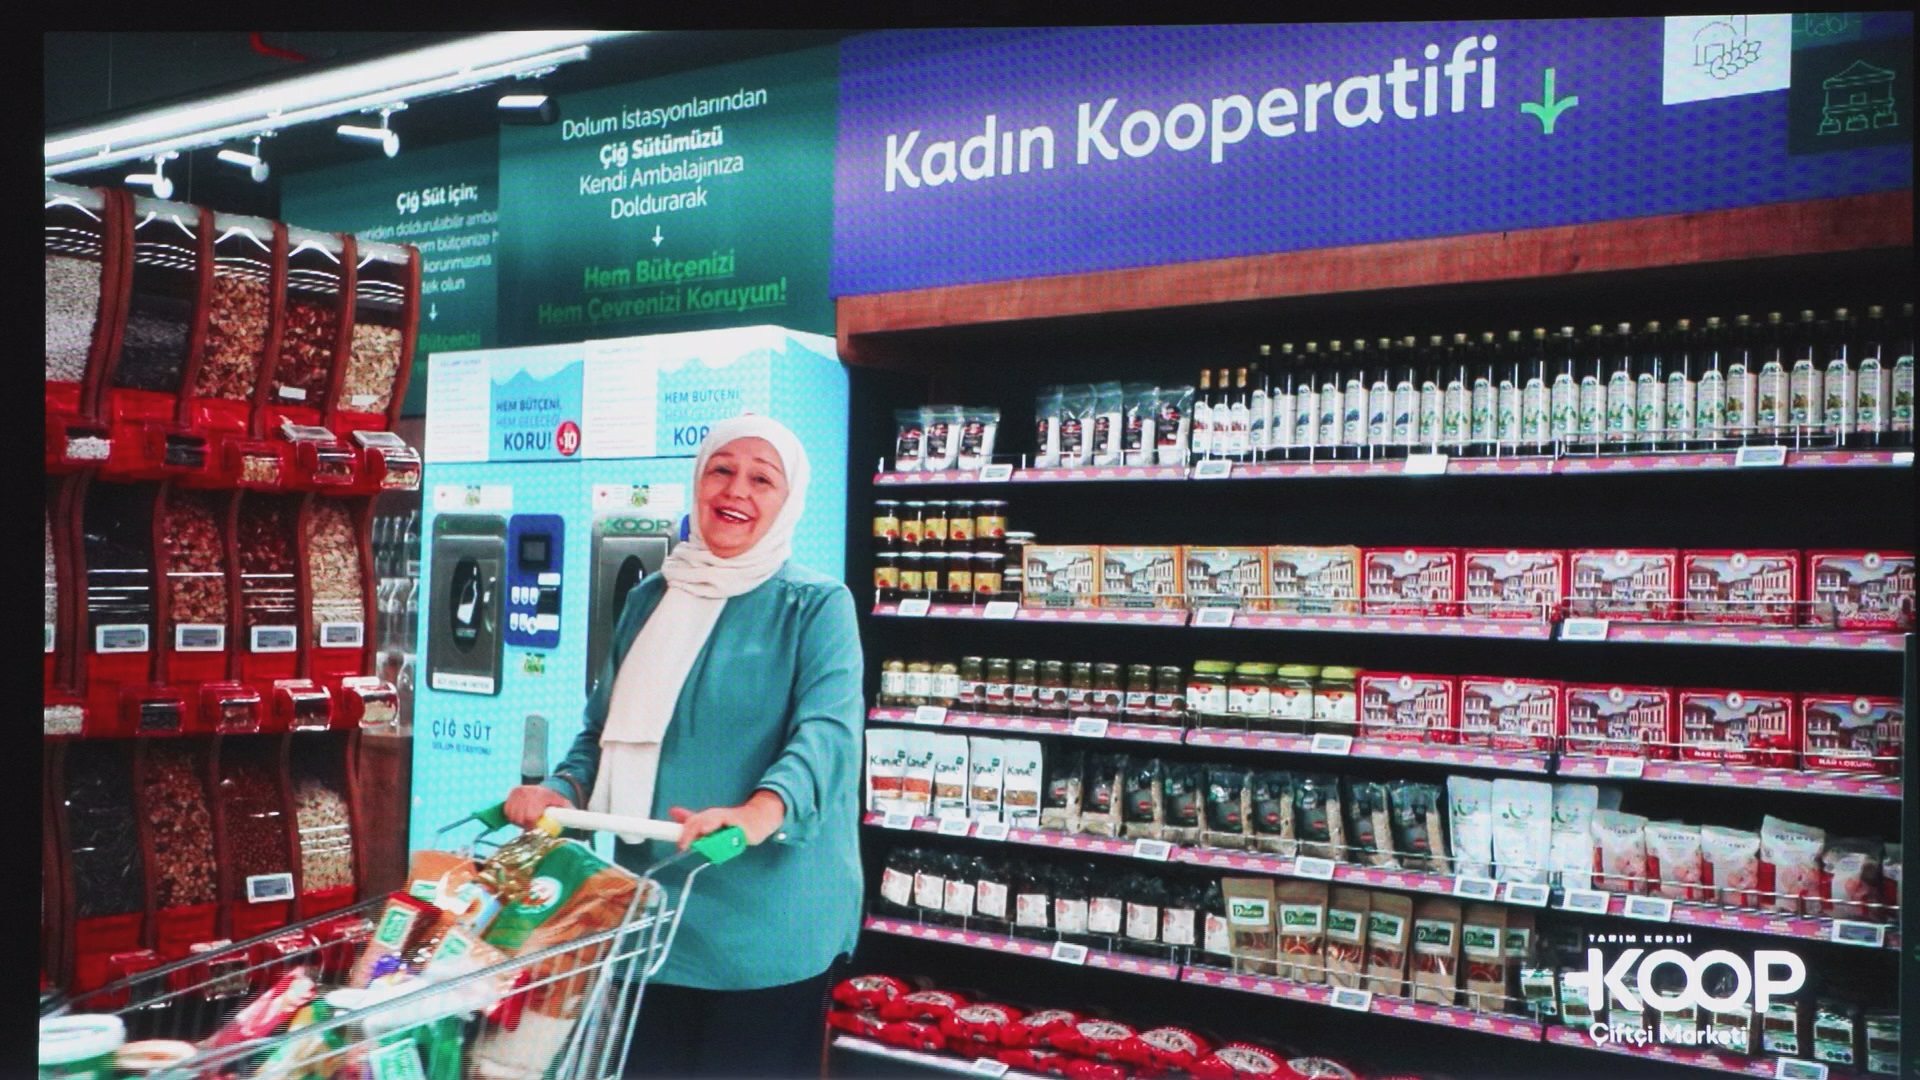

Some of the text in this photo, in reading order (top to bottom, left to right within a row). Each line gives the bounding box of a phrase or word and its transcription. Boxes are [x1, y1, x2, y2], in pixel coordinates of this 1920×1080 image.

[562, 88, 767, 140] Dolum İstasyonlarından
[885, 34, 1498, 192] Kadın Kooperatifi
[600, 126, 723, 169] Çiğ Sütümüzü
[580, 155, 743, 195] Kendi Ambalajınıza
[397, 192, 419, 215] Çiğ
[422, 187, 445, 207] Süt
[611, 187, 708, 219] Doldurarak
[584, 249, 735, 289] Hem Bütçenizi
[538, 277, 787, 324] Hem Çevrenizi Koruyun!
[432, 717, 491, 741] ÇİĞ SÜT
